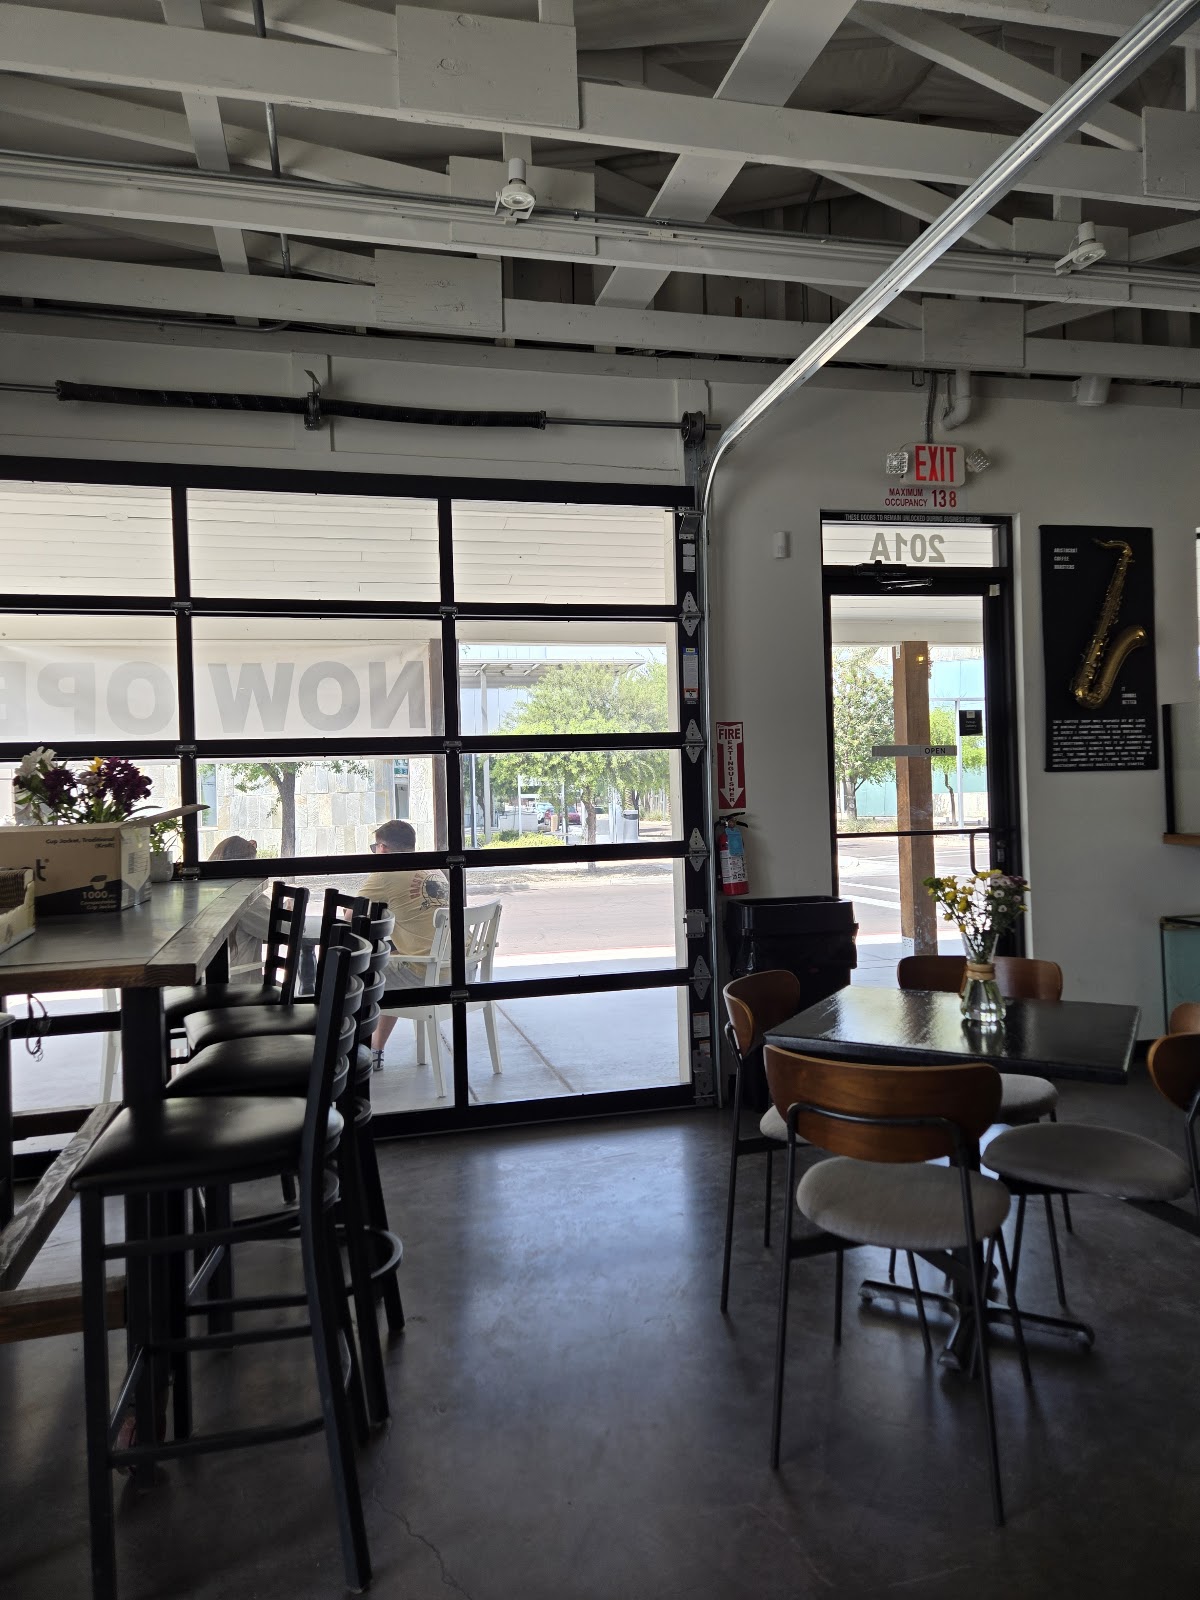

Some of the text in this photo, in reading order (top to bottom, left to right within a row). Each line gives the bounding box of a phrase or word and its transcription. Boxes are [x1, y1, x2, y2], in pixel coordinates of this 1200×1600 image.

[914, 445, 957, 483] EXIT
[889, 488, 924, 497] MAXIMUM
[884, 498, 928, 507] OCCUPANCY
[931, 489, 957, 508] 138
[845, 513, 860, 521] THESE
[884, 514, 902, 522] REMAIN
[718, 728, 741, 740] FIRE
[924, 747, 946, 755] OPEN
[727, 740, 736, 803] EXTINGUISHER
[82, 890, 108, 899] 1000
